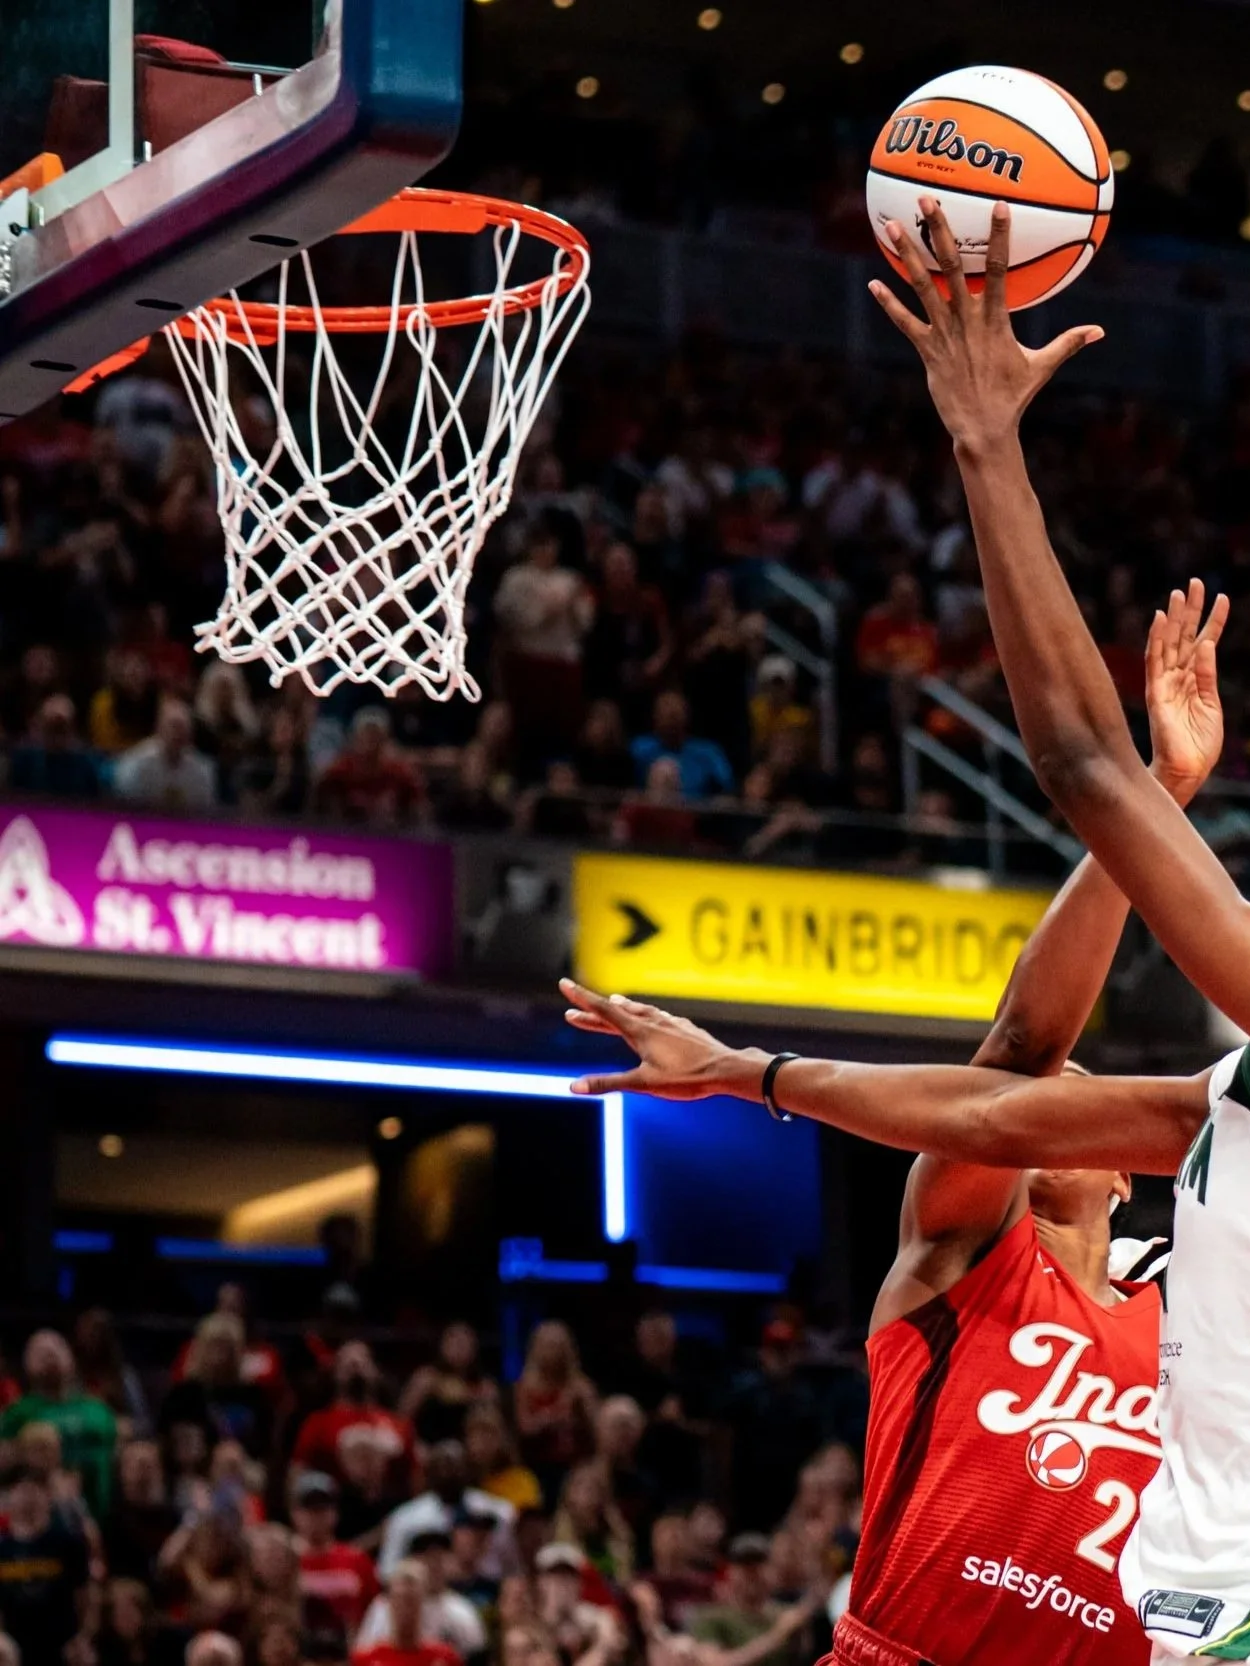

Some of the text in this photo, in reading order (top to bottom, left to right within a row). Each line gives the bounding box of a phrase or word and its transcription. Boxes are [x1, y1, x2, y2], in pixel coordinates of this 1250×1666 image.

[885, 114, 1024, 184] Wilson
[97, 821, 376, 902] Ascension
[94, 885, 388, 969] St. Vincent
[961, 1555, 1116, 1633] salesforce
